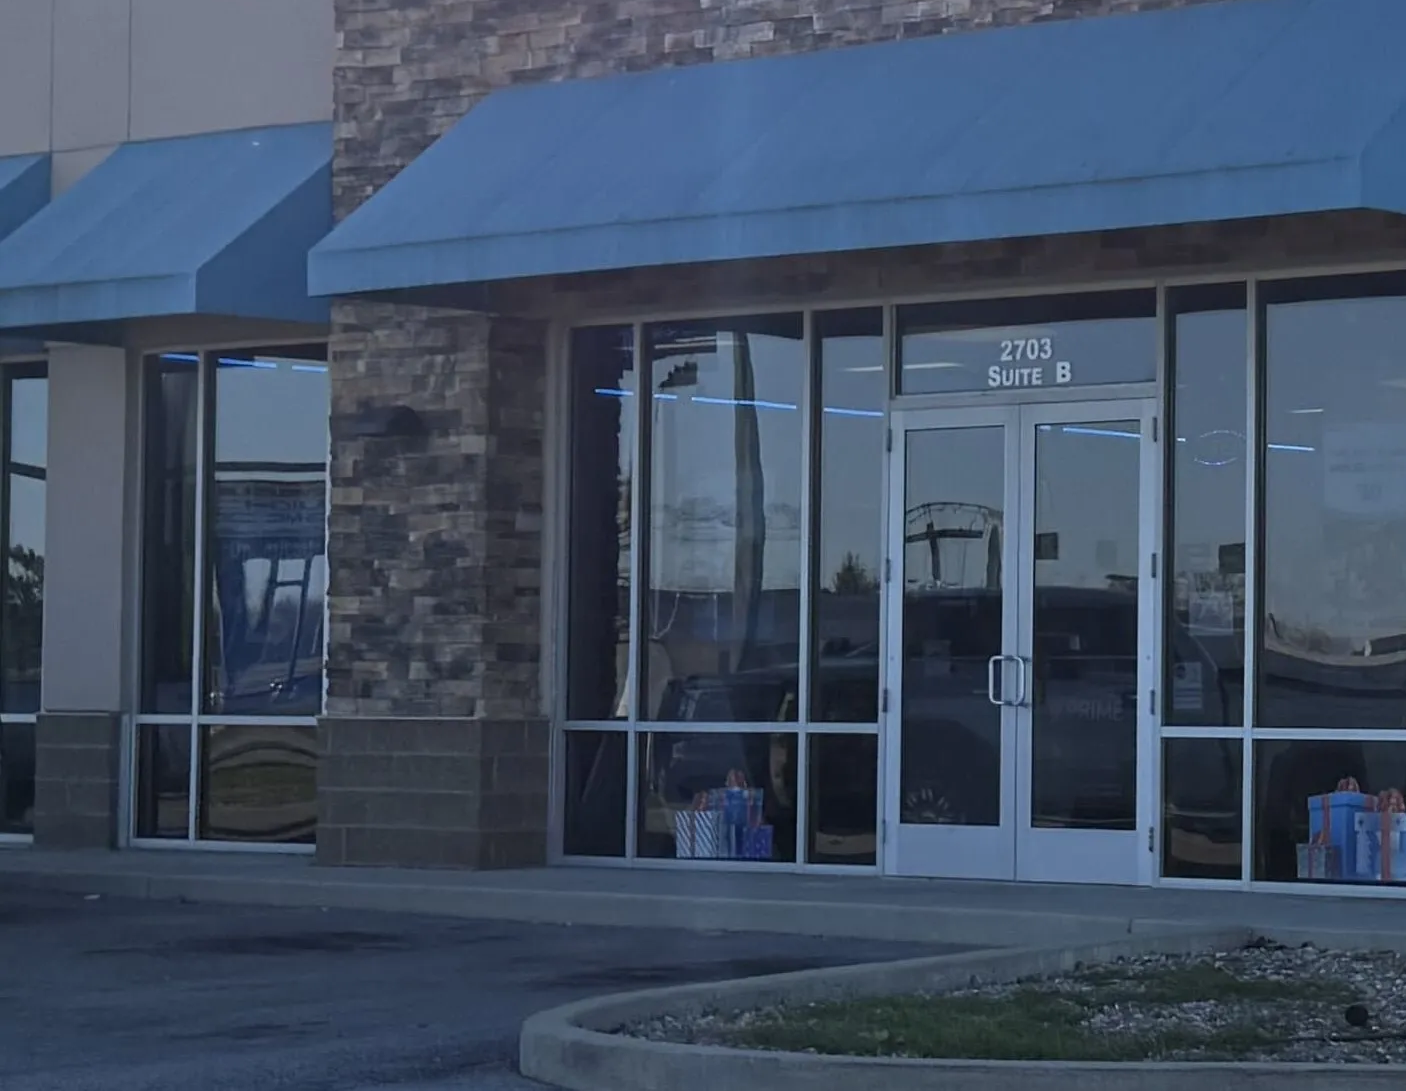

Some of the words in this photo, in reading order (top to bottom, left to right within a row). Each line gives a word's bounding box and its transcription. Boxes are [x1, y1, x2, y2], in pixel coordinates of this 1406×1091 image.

[1000, 337, 1053, 361] 2703
[987, 365, 1043, 387] SUITE
[1055, 361, 1072, 383] B
